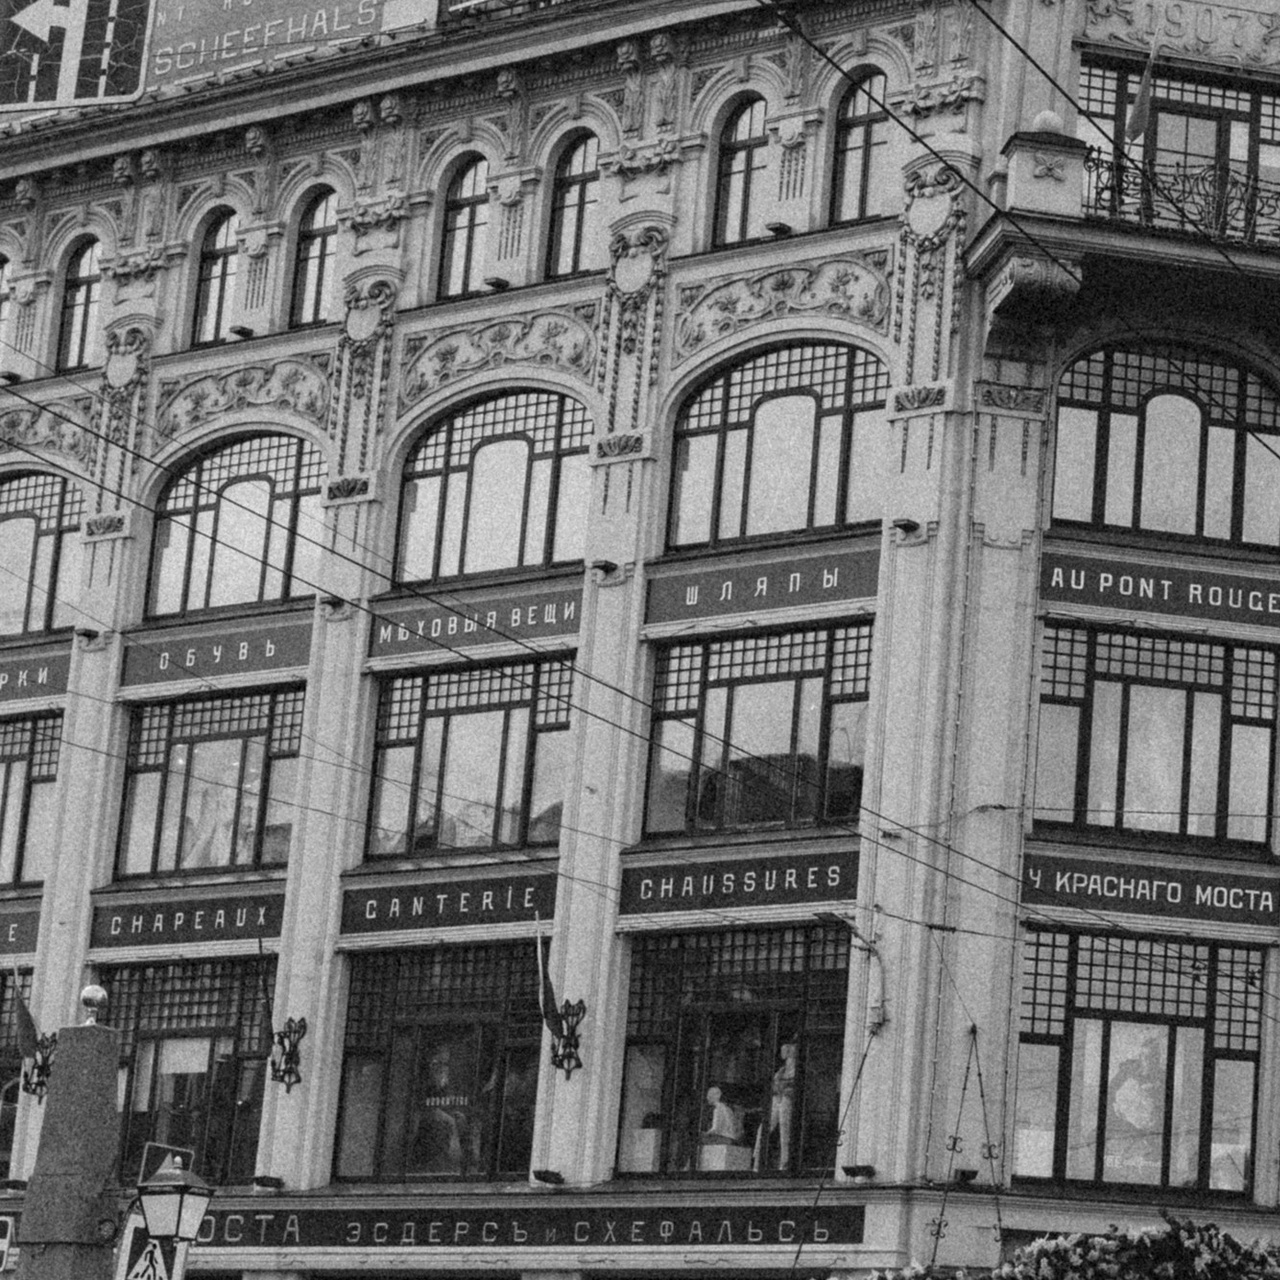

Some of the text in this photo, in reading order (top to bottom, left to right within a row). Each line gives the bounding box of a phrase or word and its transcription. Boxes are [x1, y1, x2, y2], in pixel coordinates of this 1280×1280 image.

[685, 567, 839, 606] ШЛЯПЫ
[1051, 568, 1085, 590] AU
[1099, 572, 1173, 601] PONT
[511, 601, 575, 628] ВЕЩИ
[159, 639, 275, 670] ОБУВЬ
[640, 865, 841, 900] CHAUSSURES
[1056, 871, 1182, 904] КРАСНАГО
[1195, 884, 1273, 913] МОСТА
[110, 906, 266, 935] CHAPEAUX
[346, 1221, 528, 1246] ЭСДЕРСЪ
